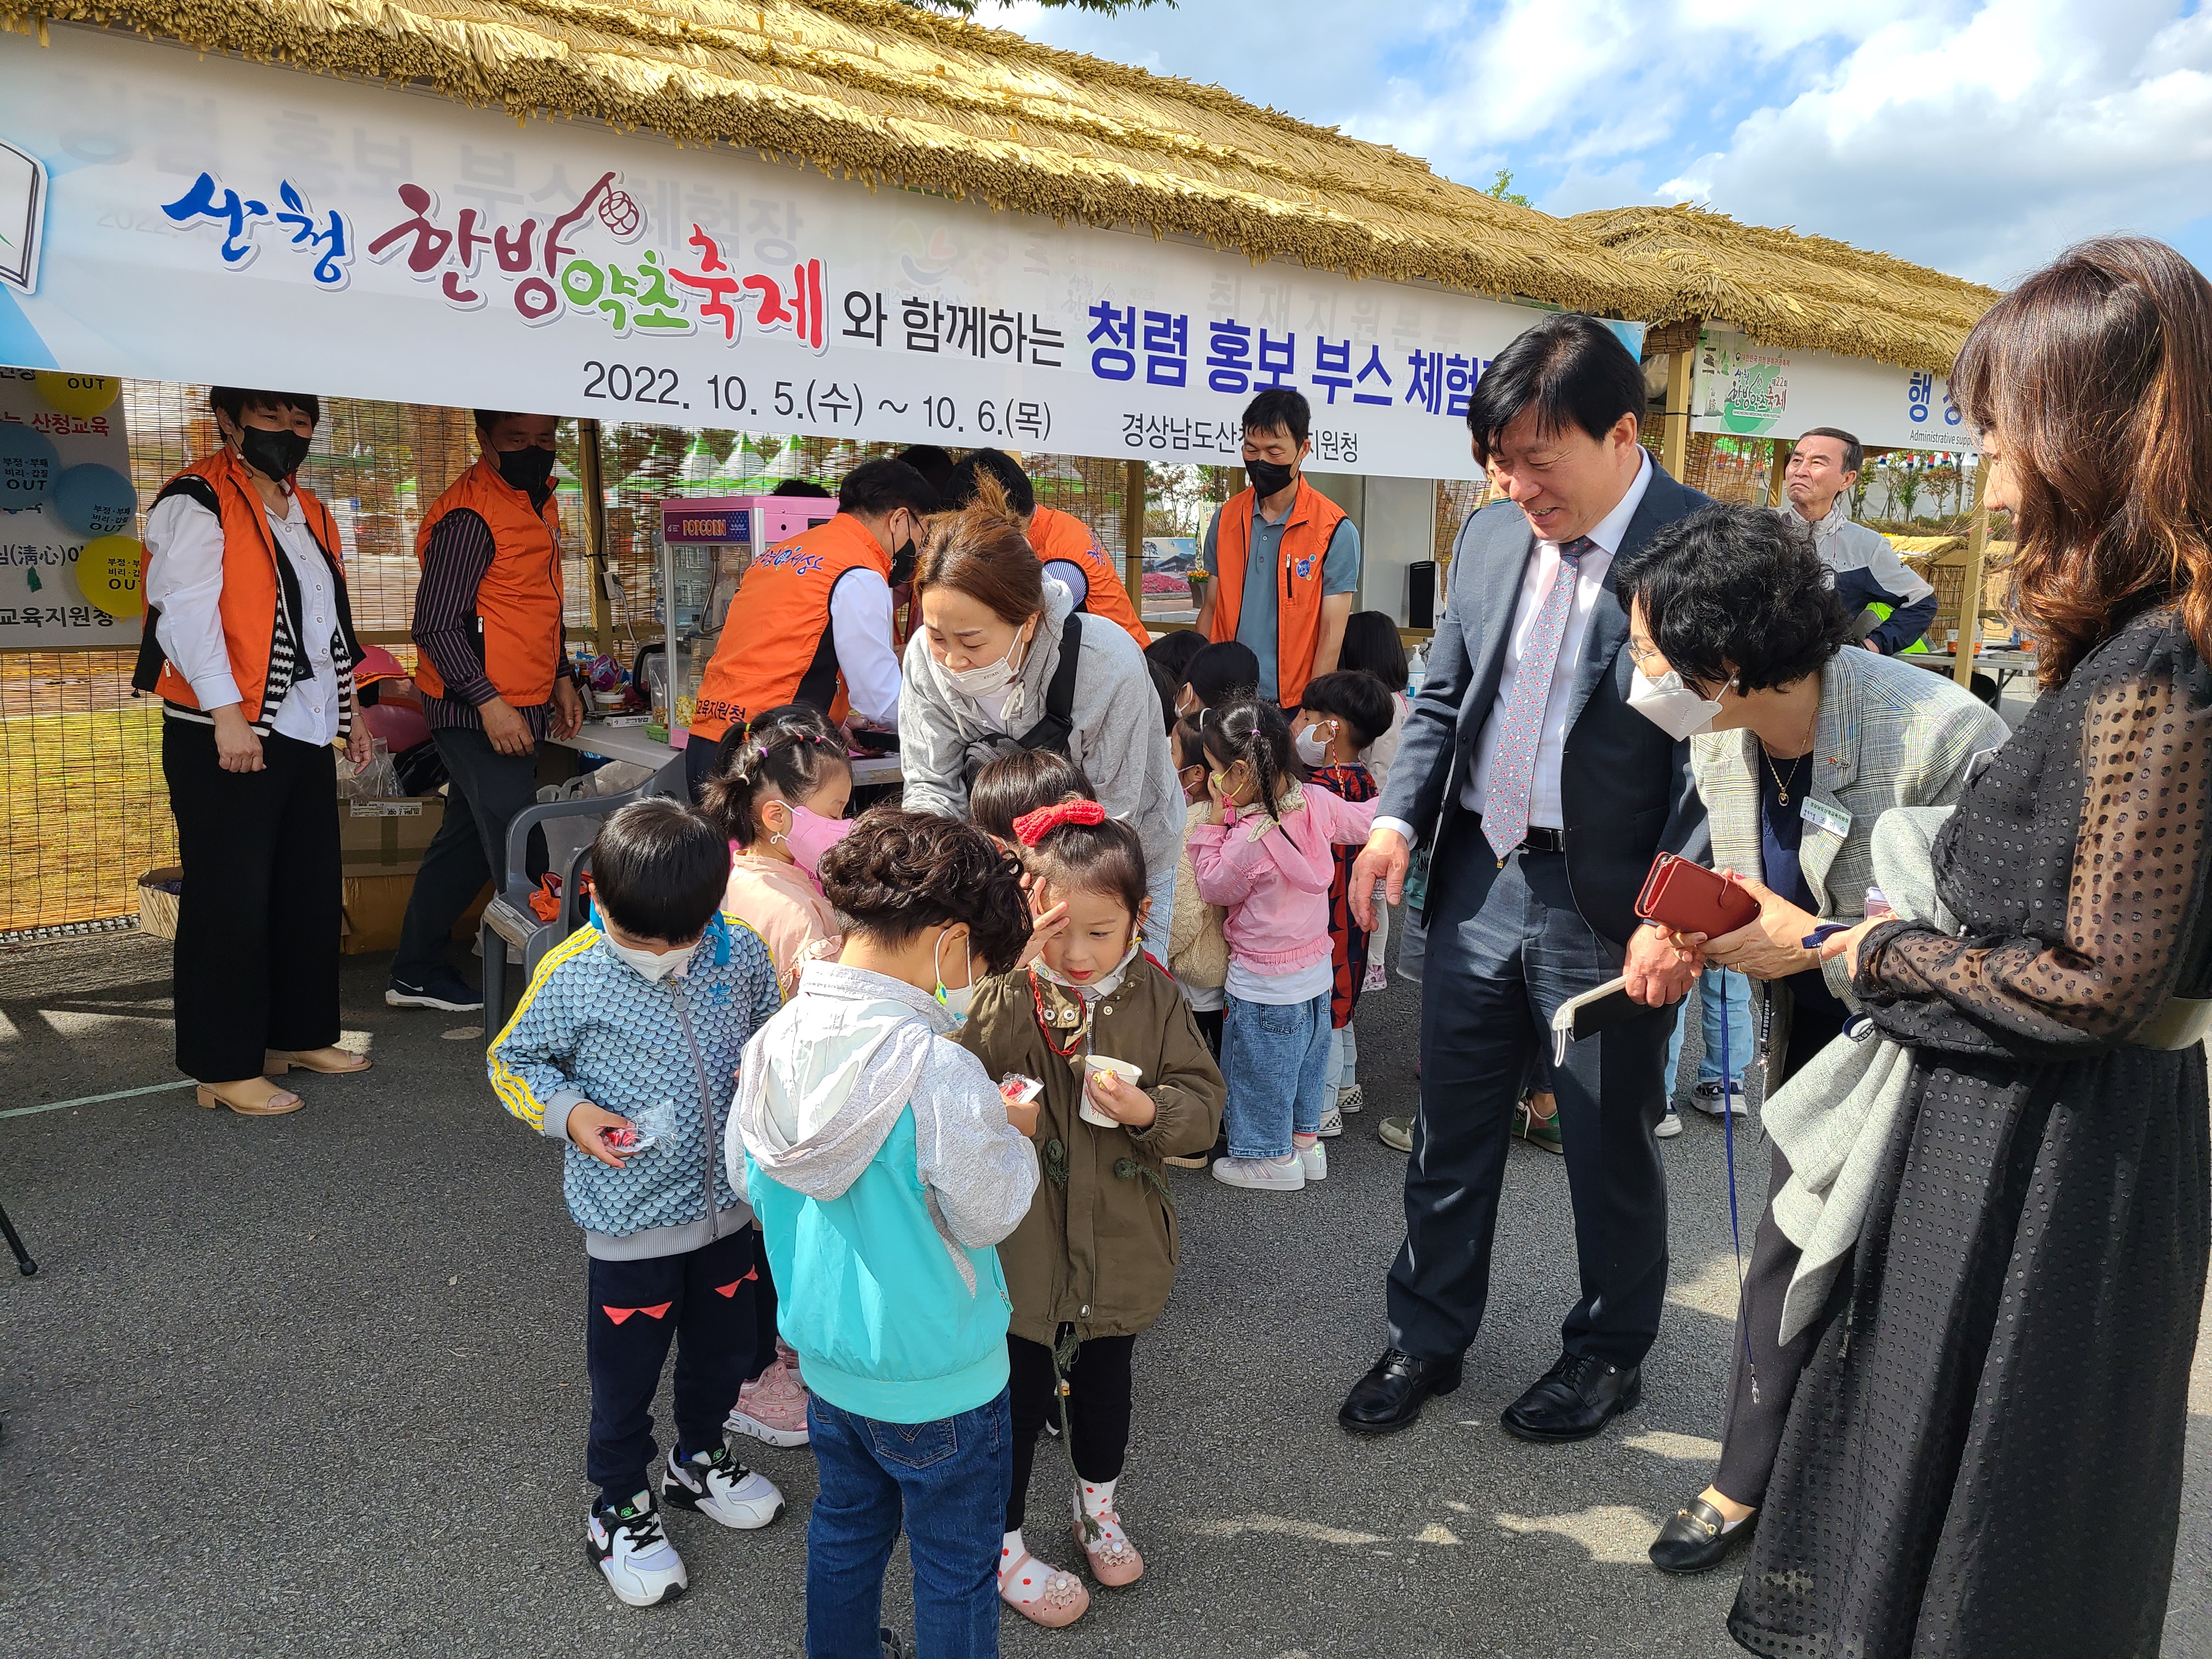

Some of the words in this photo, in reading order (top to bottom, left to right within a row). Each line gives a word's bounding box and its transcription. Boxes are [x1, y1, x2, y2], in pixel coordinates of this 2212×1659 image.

[161, 172, 346, 283] 산청
[843, 291, 888, 347] 와
[902, 296, 1064, 367] 함께하는
[1087, 300, 1188, 387] 청렴
[1206, 318, 1298, 394] 홍보
[1312, 336, 1392, 406] 부스
[1404, 348, 1493, 417] 체험
[1741, 354, 1758, 363] 대한민국
[1734, 368, 1750, 385] 산청
[1772, 376, 1788, 388] 제22회
[67, 377, 105, 390] OUT
[583, 360, 690, 410] 2022.
[707, 374, 757, 415] 10.
[774, 379, 862, 426] 5.(수)
[923, 396, 963, 432] 10.
[978, 398, 1051, 441] 6.(목)
[32, 413, 110, 437] 산청교육
[1909, 430, 1955, 444] Administrative
[7, 478, 47, 491] OUT
[89, 522, 126, 533] OUT
[682, 519, 727, 537] POPCORN
[108, 578, 141, 591] OU
